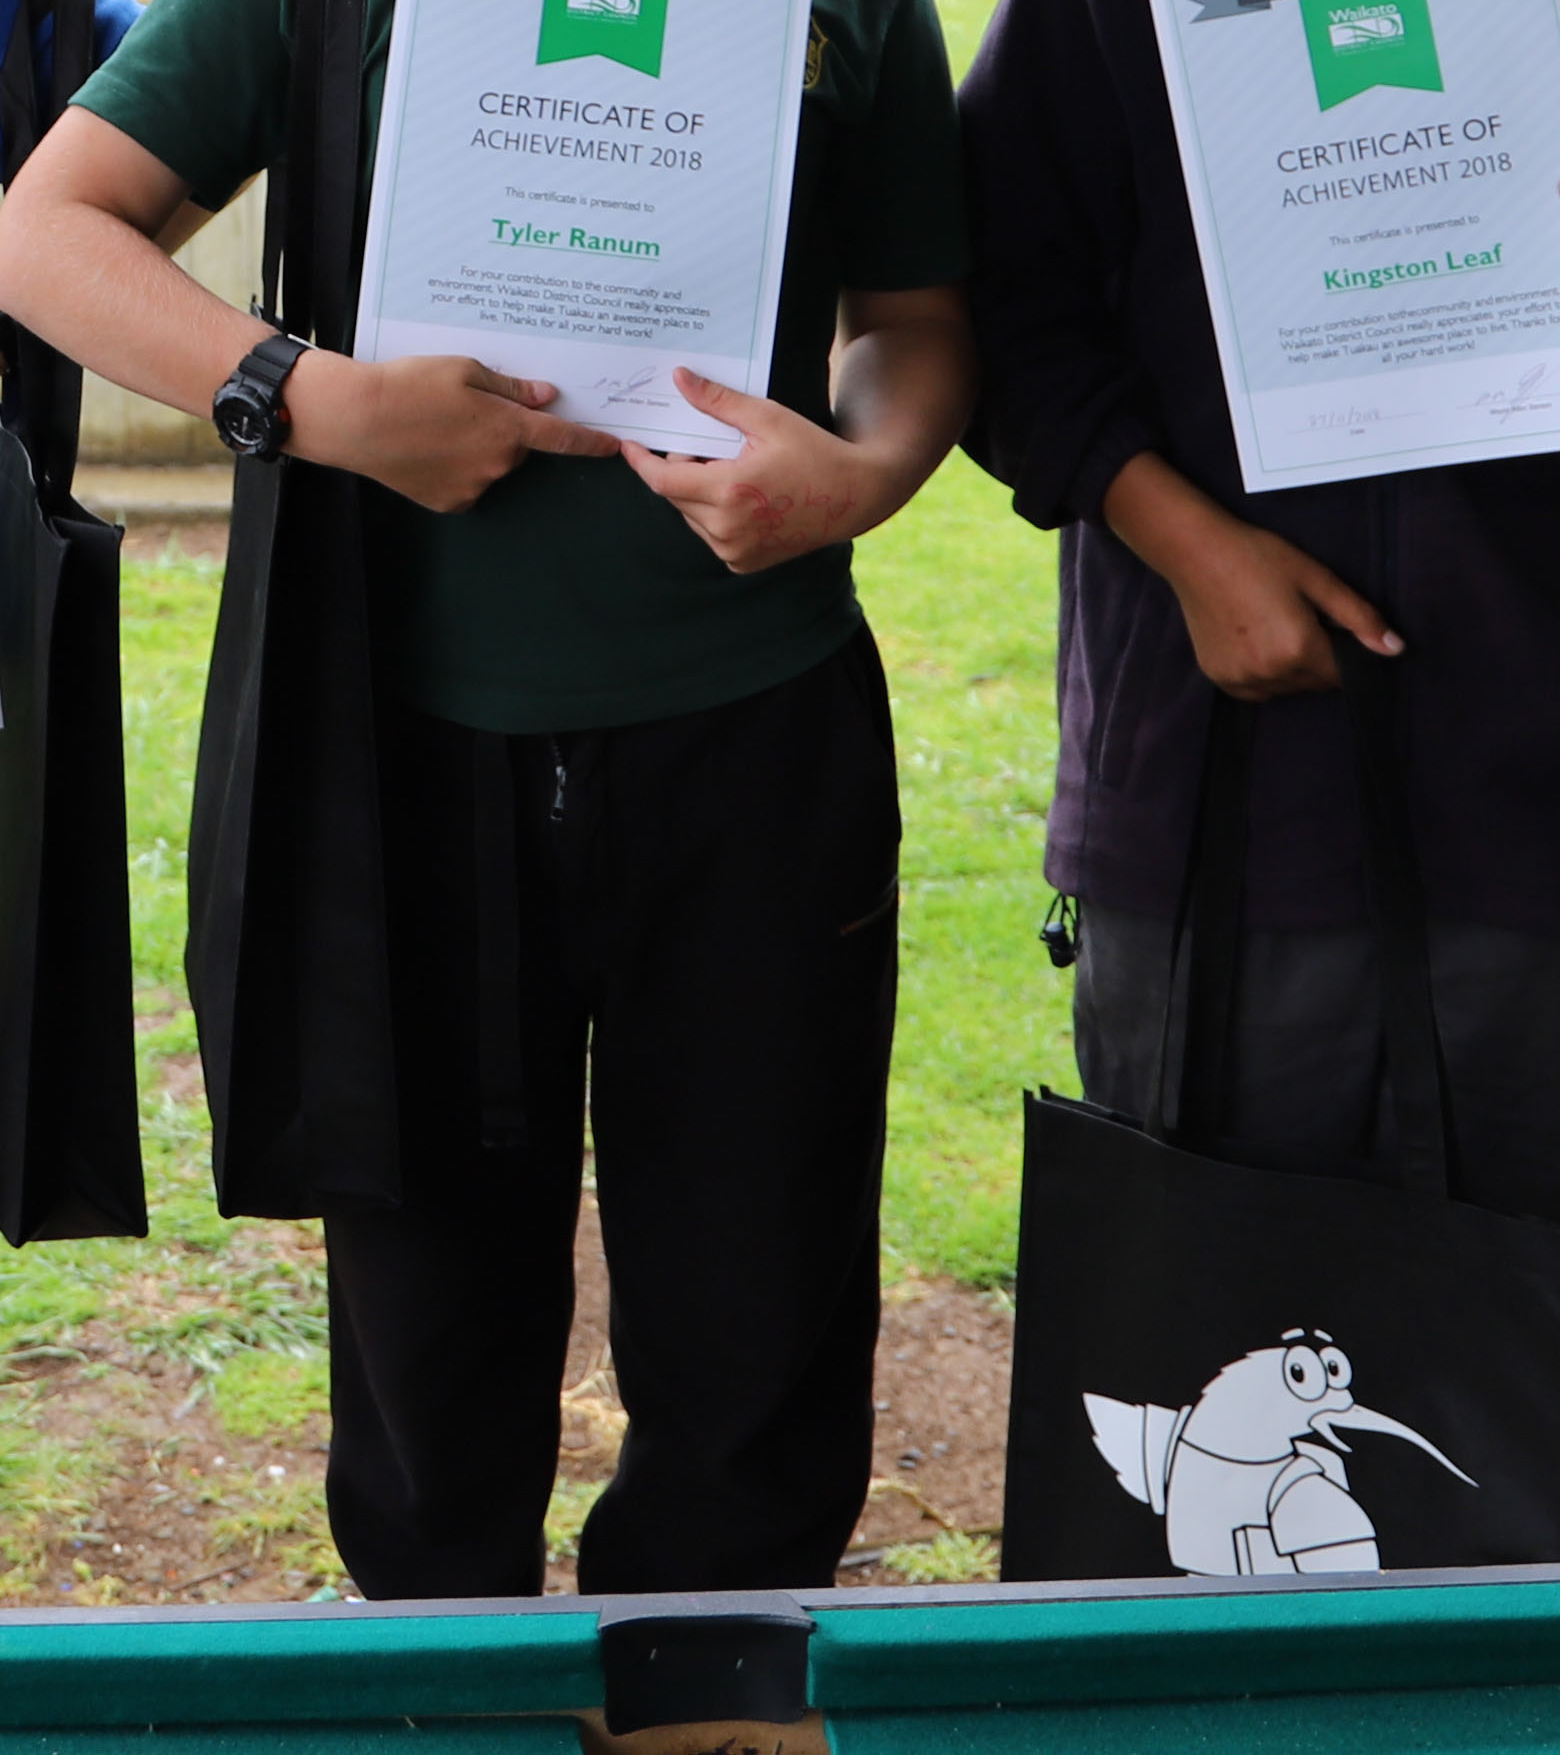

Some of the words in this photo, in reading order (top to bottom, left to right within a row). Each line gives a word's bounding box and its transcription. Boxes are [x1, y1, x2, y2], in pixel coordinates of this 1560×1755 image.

[1328, 4, 1397, 23] Waikato
[478, 92, 654, 130] CERTIFICATE
[664, 111, 703, 134] OF
[470, 128, 643, 163] ACHIEVEMENT
[649, 146, 702, 171] 2018
[1276, 123, 1453, 173] CERTIFICATE
[1462, 114, 1501, 141] OF
[505, 186, 525, 198] This
[527, 191, 577, 204] certificate
[579, 197, 587, 205] is
[589, 198, 641, 211] presented
[643, 203, 655, 213] to
[1282, 161, 1450, 208] ACHIEVEMENT
[1458, 152, 1512, 178] 2018
[491, 218, 560, 246] Tyler
[569, 227, 660, 256] Ranum
[1329, 235, 1350, 245] This
[1353, 228, 1401, 243] certificate
[1404, 226, 1412, 234] is
[1415, 216, 1466, 235] presented
[1467, 215, 1480, 224] to
[1323, 260, 1437, 290] Kingston
[1445, 242, 1502, 270] Leaf
